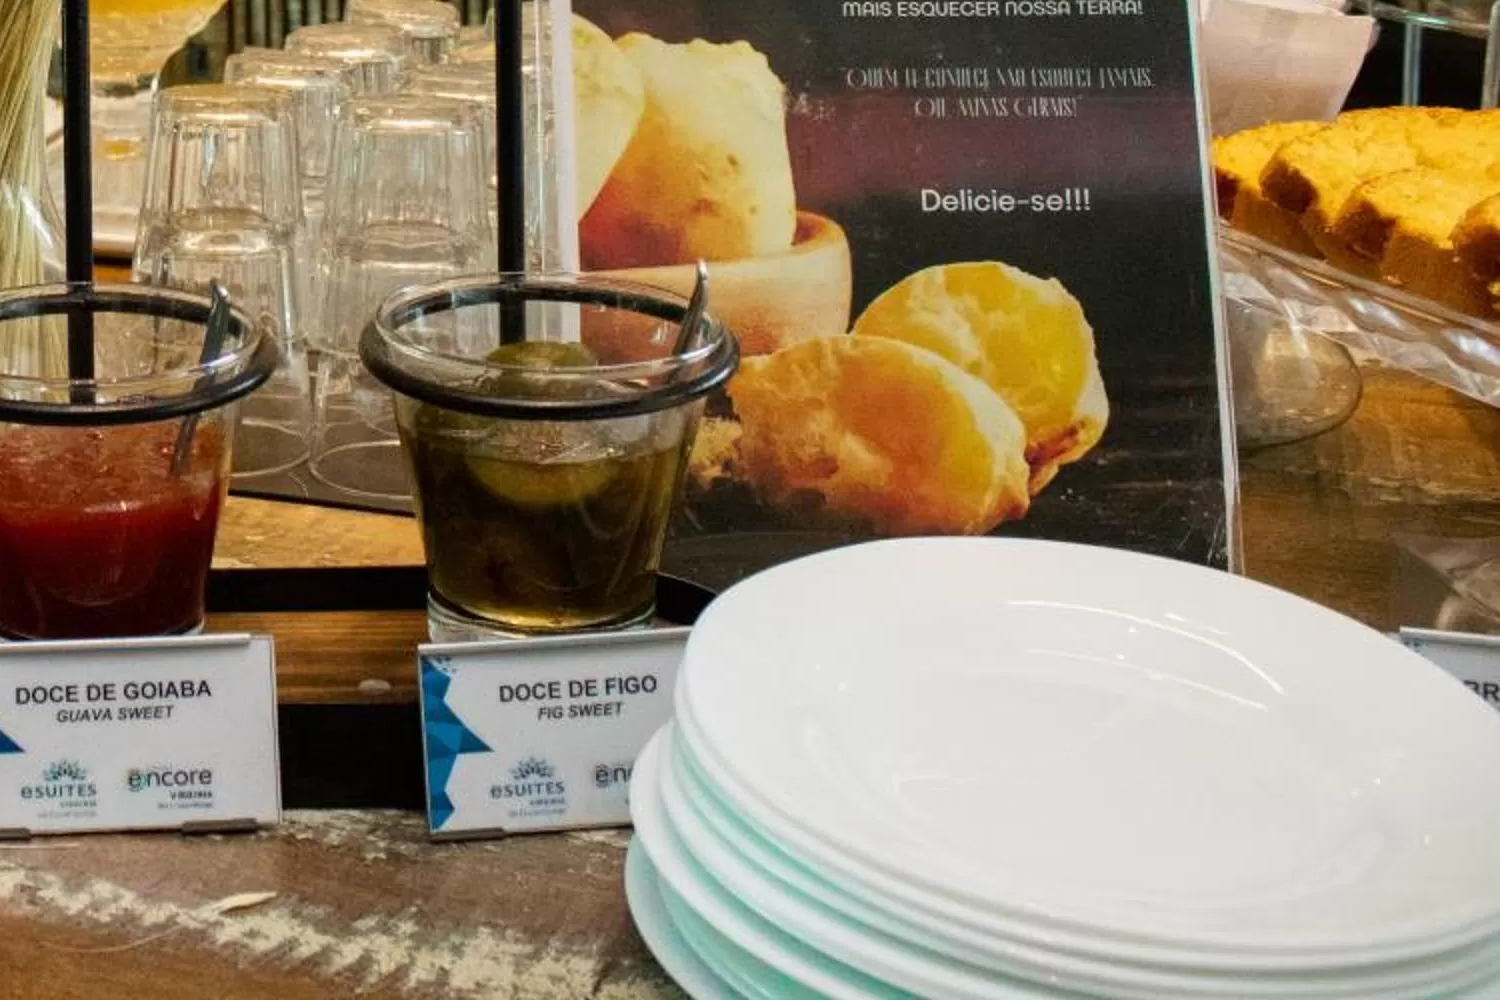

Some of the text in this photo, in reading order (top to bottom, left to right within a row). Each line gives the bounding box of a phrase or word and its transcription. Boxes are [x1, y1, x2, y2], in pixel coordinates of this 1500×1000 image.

[842, 0, 1145, 18] MAIS ESQUECER NOSSA TERRA!
[921, 187, 1091, 212] Delicie-se!!!
[15, 680, 212, 704] DOCE DE GOIABA
[499, 675, 658, 703] DOCE DE FIGO
[56, 705, 175, 723] GUAVA SWEET
[537, 701, 625, 720] FIG SWEET
[127, 767, 212, 792] encore
